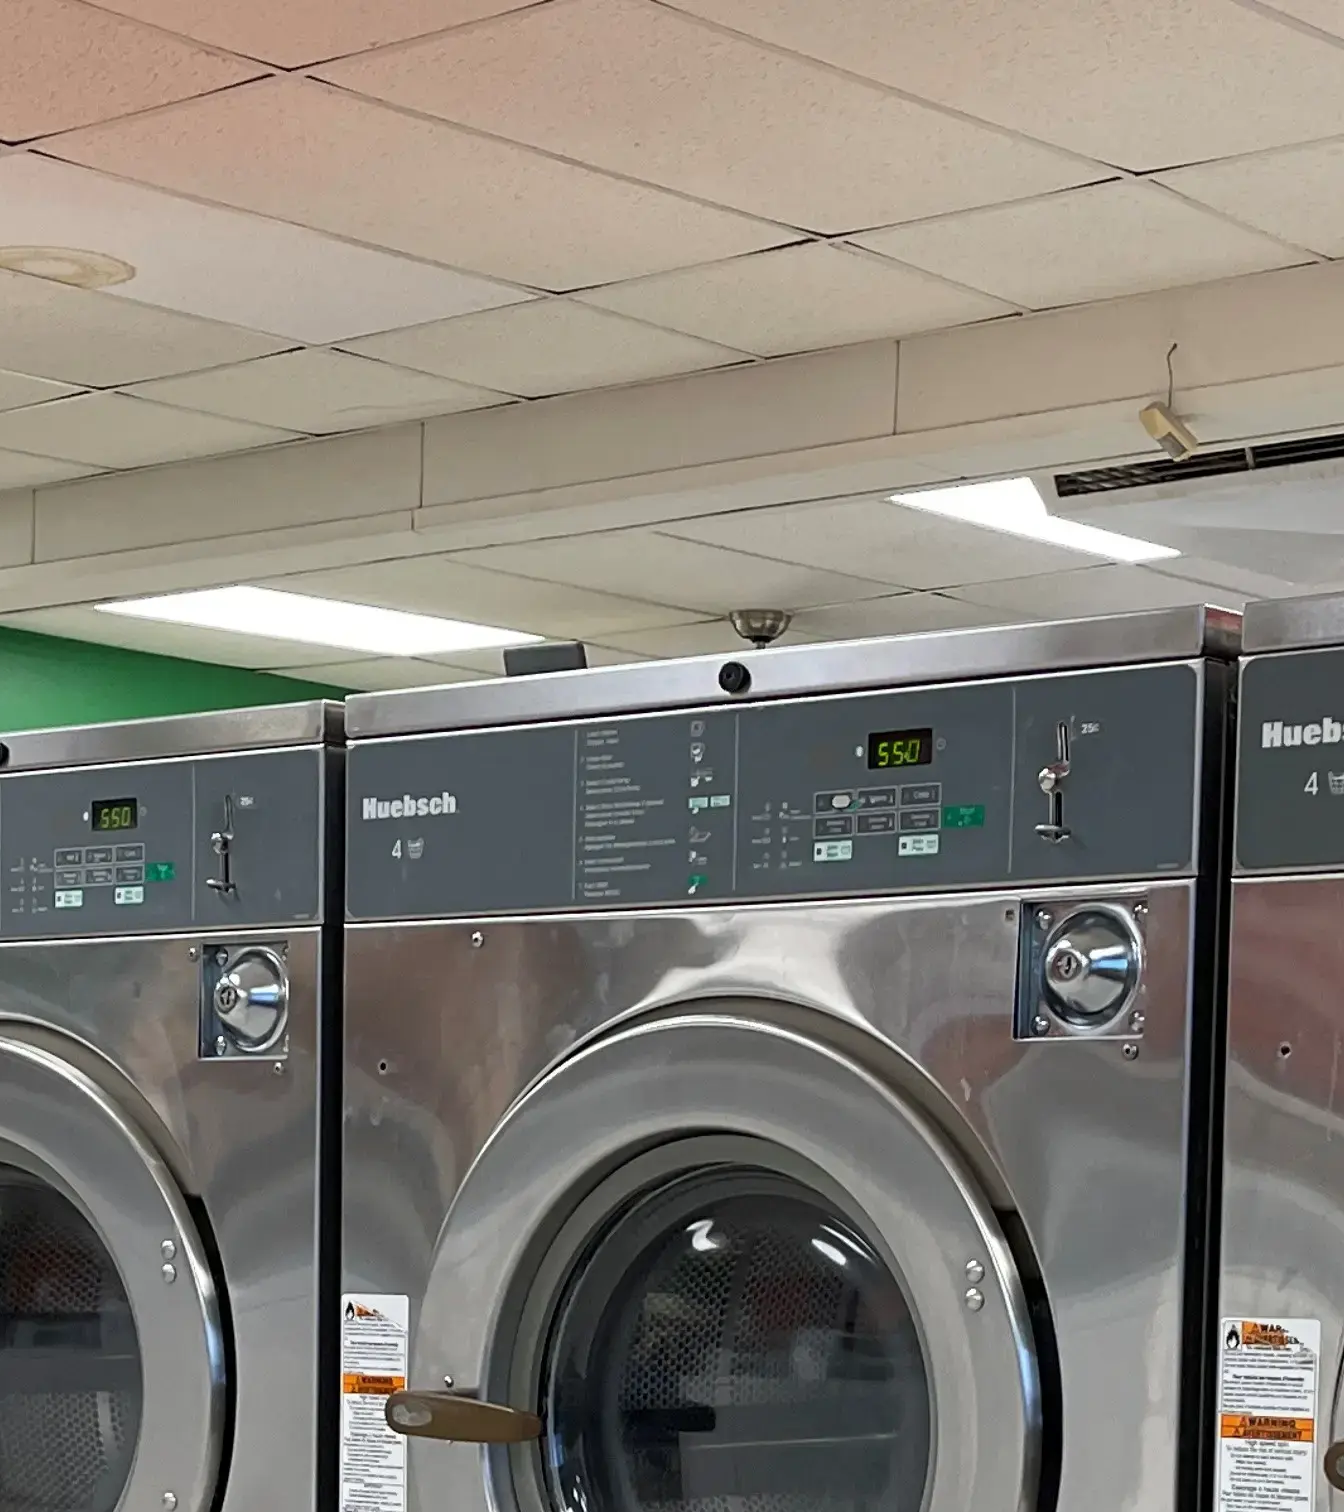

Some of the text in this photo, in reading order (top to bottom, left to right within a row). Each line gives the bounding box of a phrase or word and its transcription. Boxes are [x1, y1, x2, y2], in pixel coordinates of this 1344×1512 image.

[1304, 771, 1319, 796] 4
[362, 791, 457, 820] Huebsch
[391, 839, 402, 859] 4
